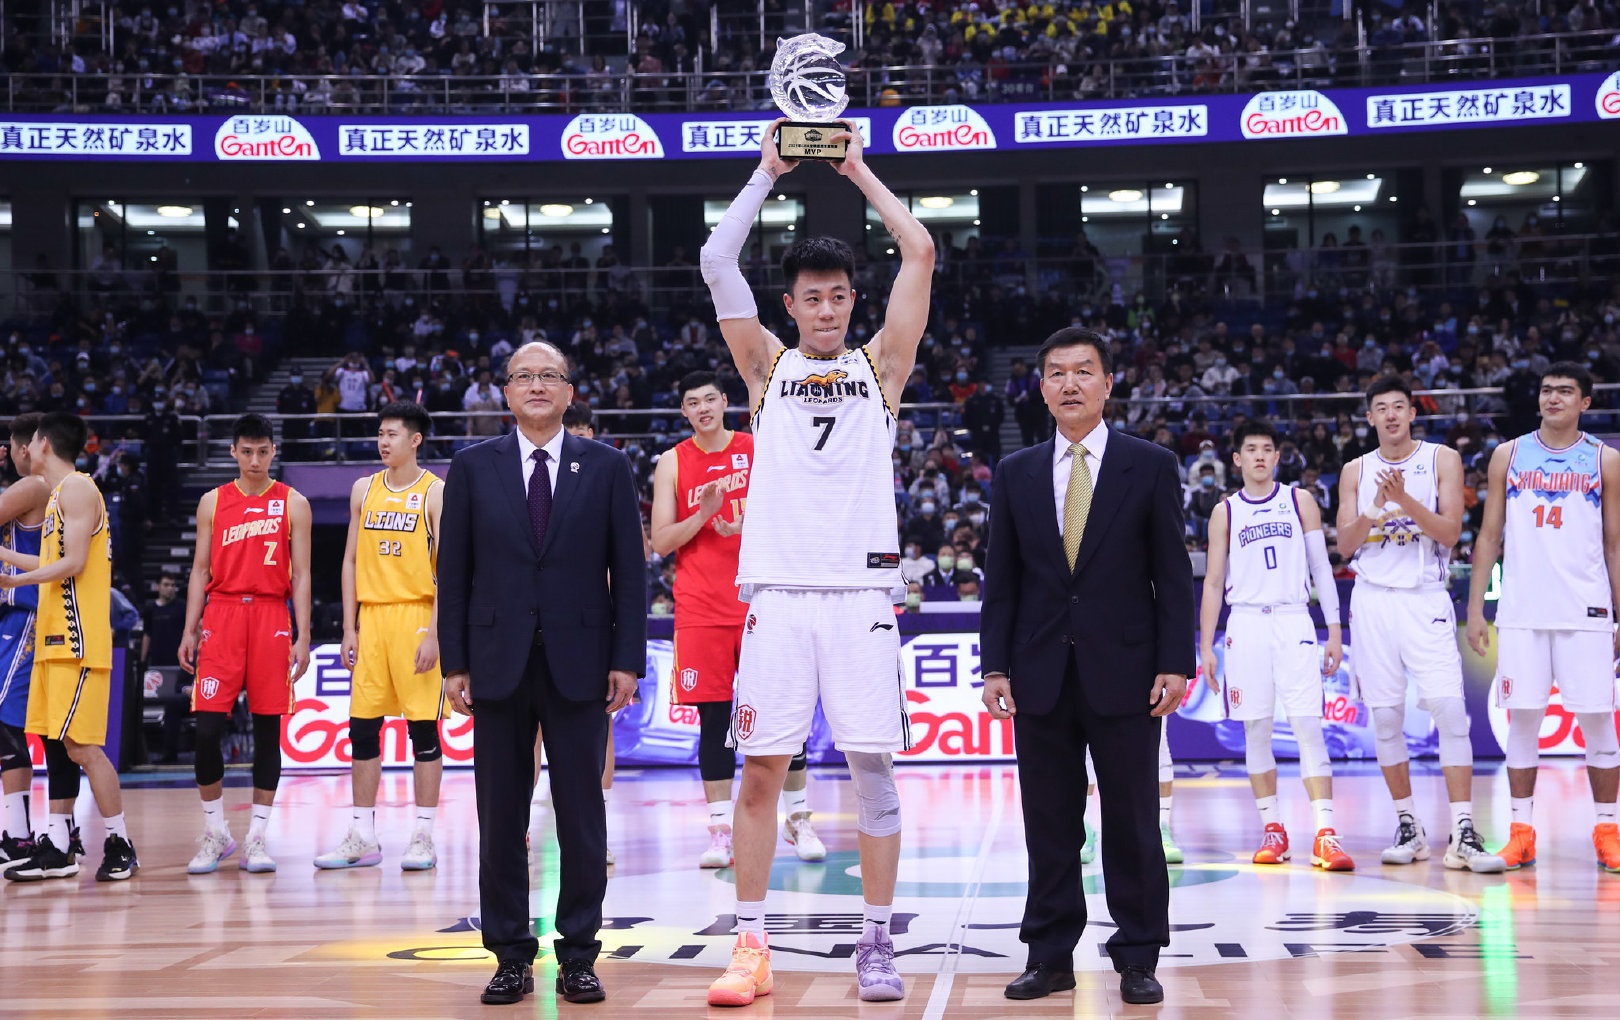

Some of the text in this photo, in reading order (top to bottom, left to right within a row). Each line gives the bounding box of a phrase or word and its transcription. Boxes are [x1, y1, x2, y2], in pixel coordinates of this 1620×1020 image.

[1259, 92, 1319, 112] 百岁山
[1374, 89, 1564, 123] 真正天然矿泉水
[233, 119, 292, 134] 百岁山
[578, 117, 637, 133] 百岁山
[910, 108, 969, 125] 百岁山
[1021, 109, 1201, 138] 真正天然矿泉水
[0, 126, 187, 151] 真正天然矿泉水
[344, 127, 524, 152] 真正天然矿泉水
[804, 148, 822, 156] MVP
[779, 380, 870, 399] LIAONING
[811, 416, 836, 451] 7
[1516, 471, 1592, 494] XINJIANG
[364, 511, 419, 532] LIONS
[1532, 505, 1563, 530] 14
[222, 516, 283, 547] LEOPARDS
[1238, 522, 1293, 548] PIONEERS
[379, 539, 402, 557] 32
[1264, 545, 1278, 570] 0
